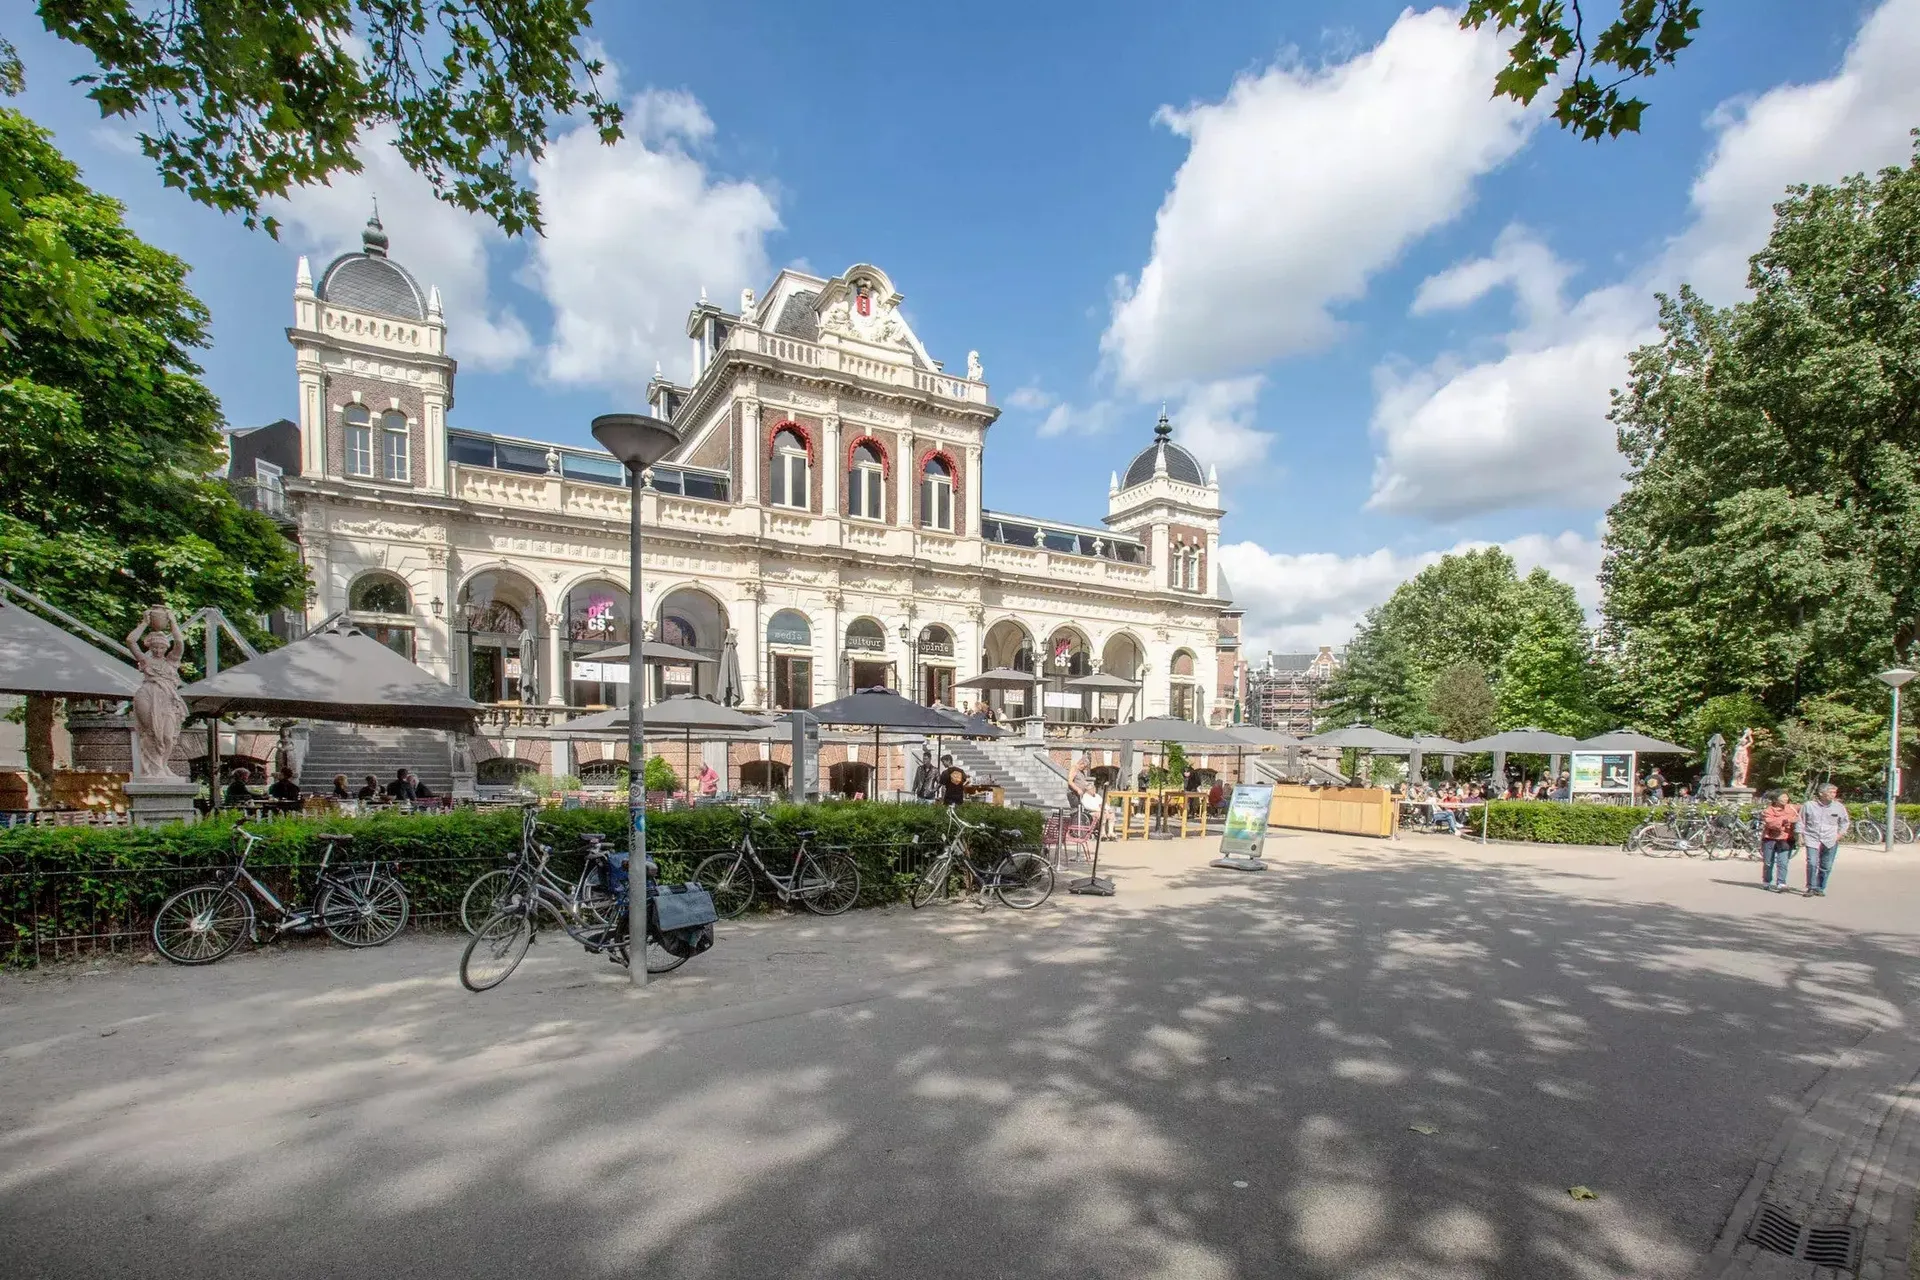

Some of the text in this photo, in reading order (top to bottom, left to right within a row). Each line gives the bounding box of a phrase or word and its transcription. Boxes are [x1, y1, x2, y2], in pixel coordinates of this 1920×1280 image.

[774, 631, 803, 641] media
[847, 637, 881, 647] cultuur
[920, 642, 949, 653] opinie
